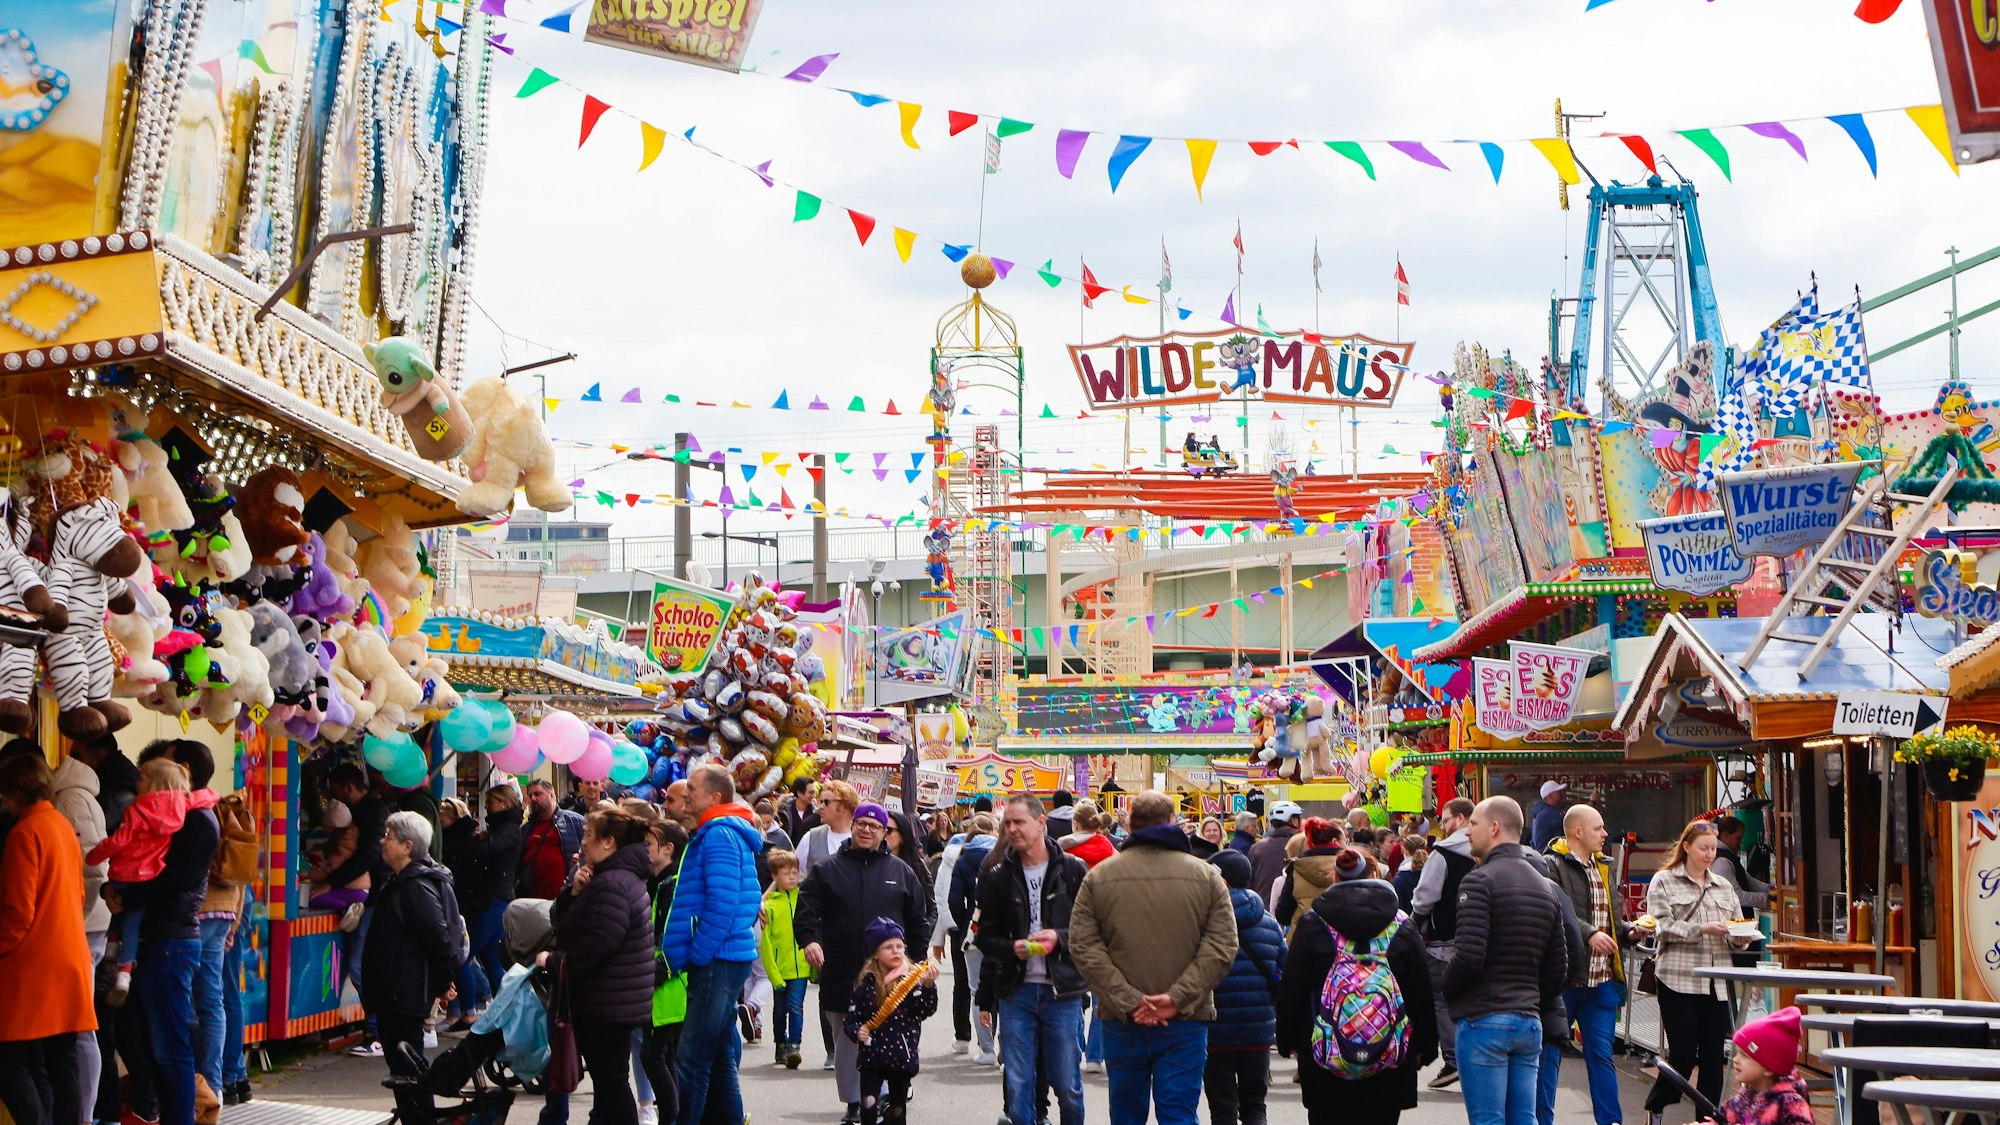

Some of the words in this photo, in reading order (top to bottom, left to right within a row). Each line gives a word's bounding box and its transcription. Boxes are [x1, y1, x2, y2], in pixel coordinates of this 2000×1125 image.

[627, 24, 664, 45] für
[670, 31, 734, 60] Alle!
[1081, 341, 1216, 401] WILDE
[1263, 340, 1400, 400] MAUS
[1729, 476, 1850, 517] Wurst-
[1736, 509, 1837, 546] Spezialitäten
[1657, 544, 1745, 576] POMMES
[653, 601, 720, 628] Schoko-
[653, 624, 712, 649] früchte
[1517, 651, 1581, 672] SOFT
[1516, 698, 1569, 720] EISMOHR
[1842, 702, 1915, 727] Toiletten
[963, 763, 1038, 791] ASSE
